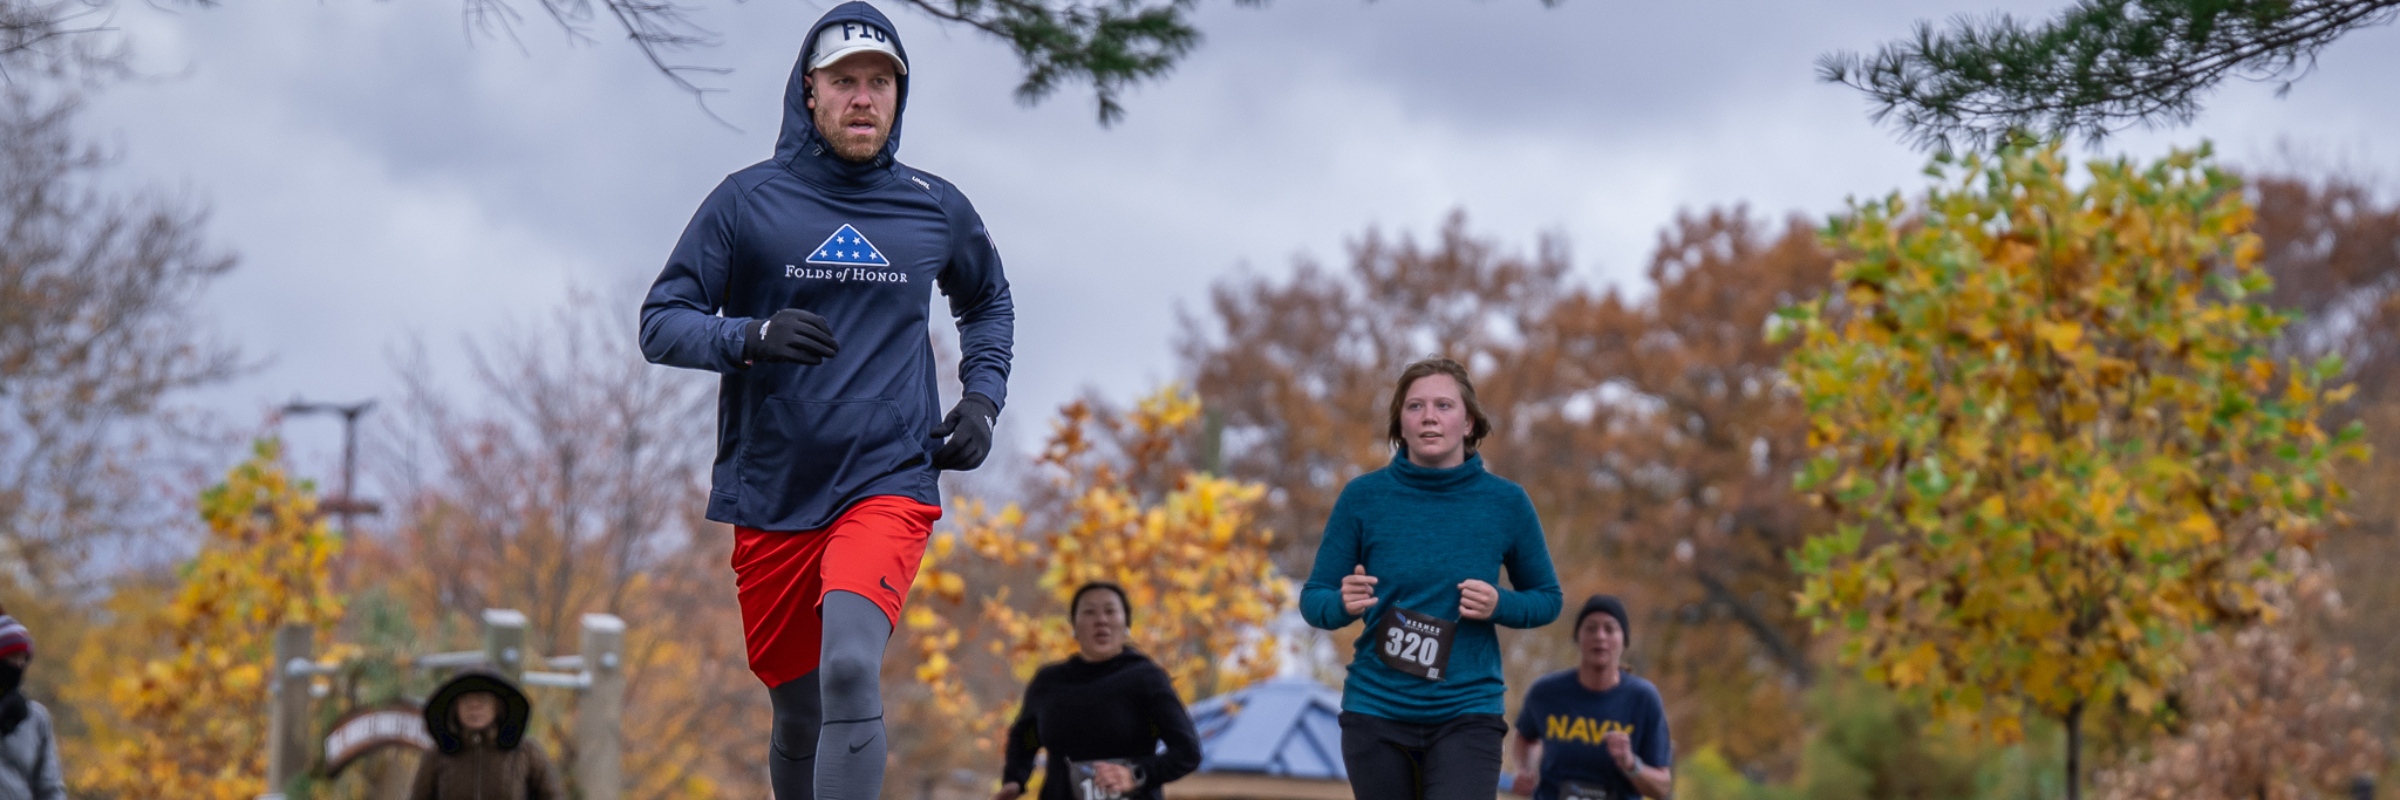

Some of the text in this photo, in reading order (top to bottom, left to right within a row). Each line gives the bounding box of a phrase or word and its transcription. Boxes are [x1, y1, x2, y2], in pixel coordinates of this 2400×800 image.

[785, 265, 908, 283] FOLDS of HONOR
[1384, 626, 1439, 667] 320
